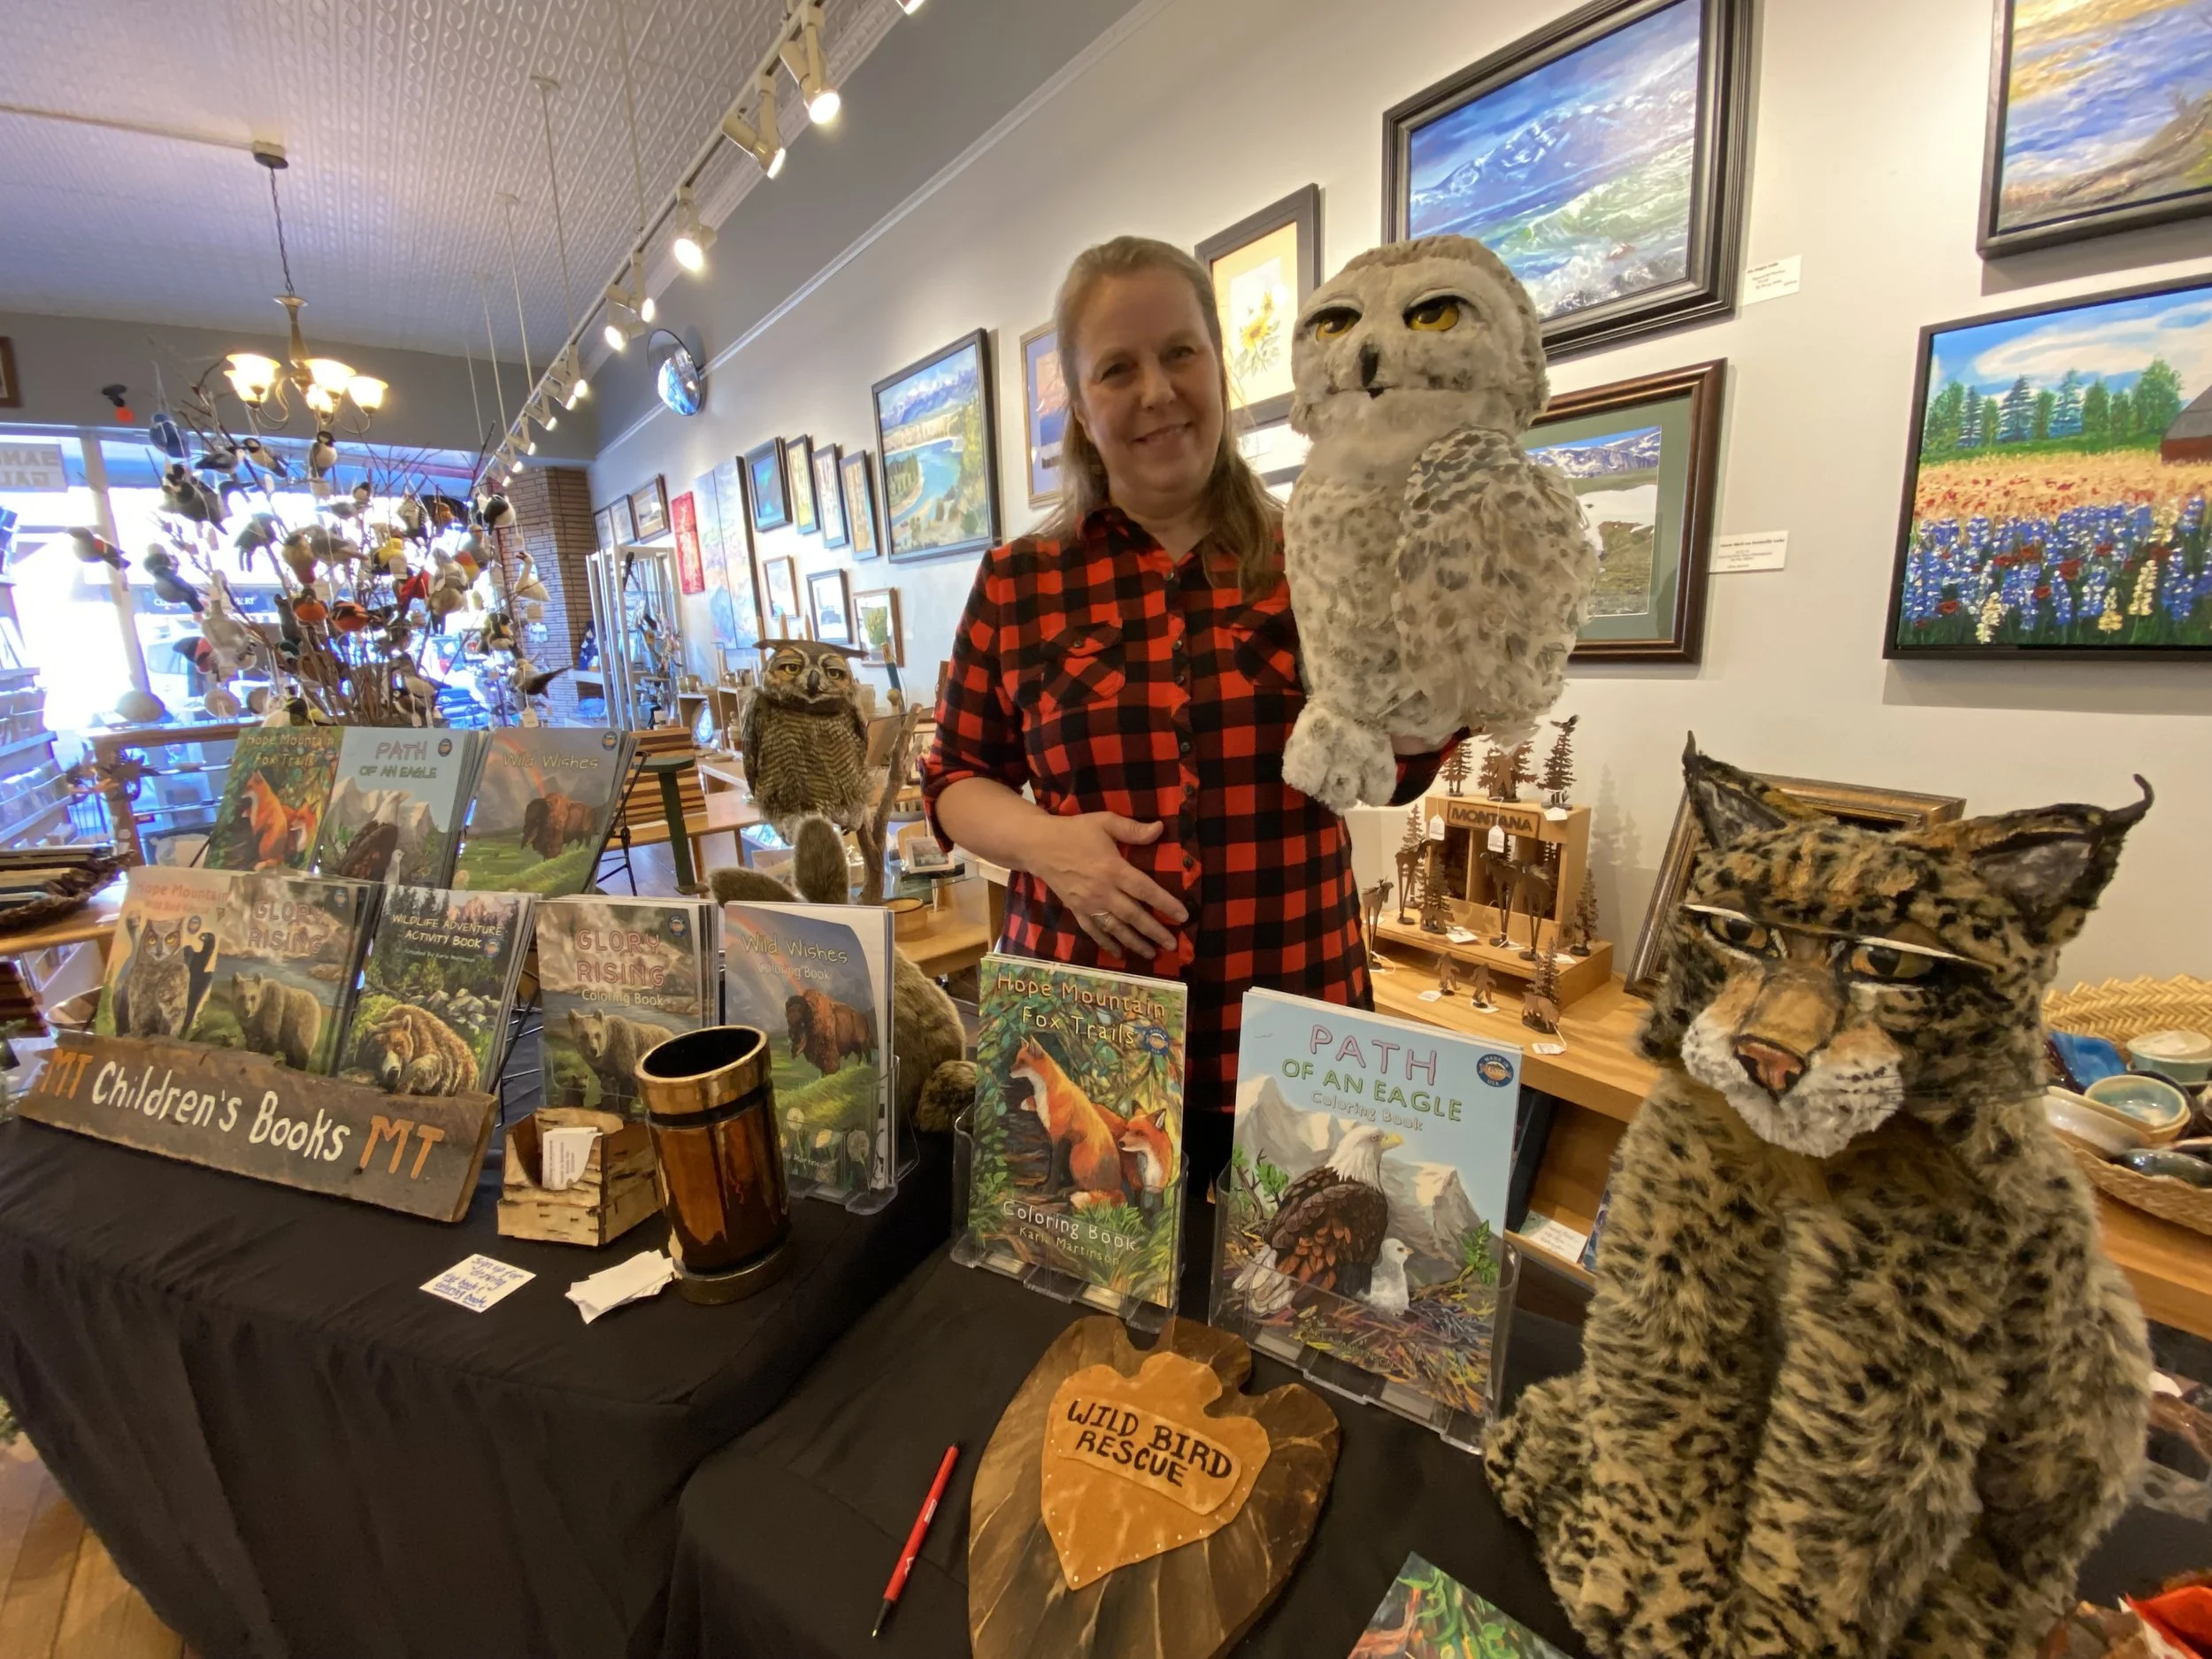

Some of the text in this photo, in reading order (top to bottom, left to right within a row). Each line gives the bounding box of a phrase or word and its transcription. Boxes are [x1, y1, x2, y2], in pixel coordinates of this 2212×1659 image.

[280, 733, 334, 745] Mountain
[375, 741, 428, 760] PATH
[254, 752, 275, 764] Fox
[503, 753, 598, 769] Wild Wishes
[359, 765, 437, 779] OF AN EAGLE
[1451, 808, 1532, 832] MONTANA
[254, 900, 326, 926] GLORY
[392, 913, 503, 937] WILDLIFE ADVENTURE
[249, 928, 322, 954] RISING
[404, 930, 449, 946] ACTIVITY
[452, 935, 482, 949] BOOK
[577, 929, 660, 953] GLORY
[741, 933, 848, 964] Wild Wishes
[576, 960, 664, 987] RISING
[757, 961, 831, 980] Coloring Book
[581, 987, 664, 1006] Coloring Book
[996, 972, 1165, 1020] Hope Mountain
[1022, 1005, 1136, 1045] Fox Trails
[1310, 1024, 1438, 1087] PATH
[1282, 1057, 1463, 1122] OF AN EAGLE
[40, 1048, 445, 1179] MT Children's Books MT
[1310, 1089, 1424, 1133] Coloring Book
[1002, 1200, 1139, 1252] Coloring Book
[1056, 1239, 1120, 1266] Martinson
[1067, 1399, 1233, 1479] WILD BIRD
[1075, 1429, 1189, 1488] RESCUE
